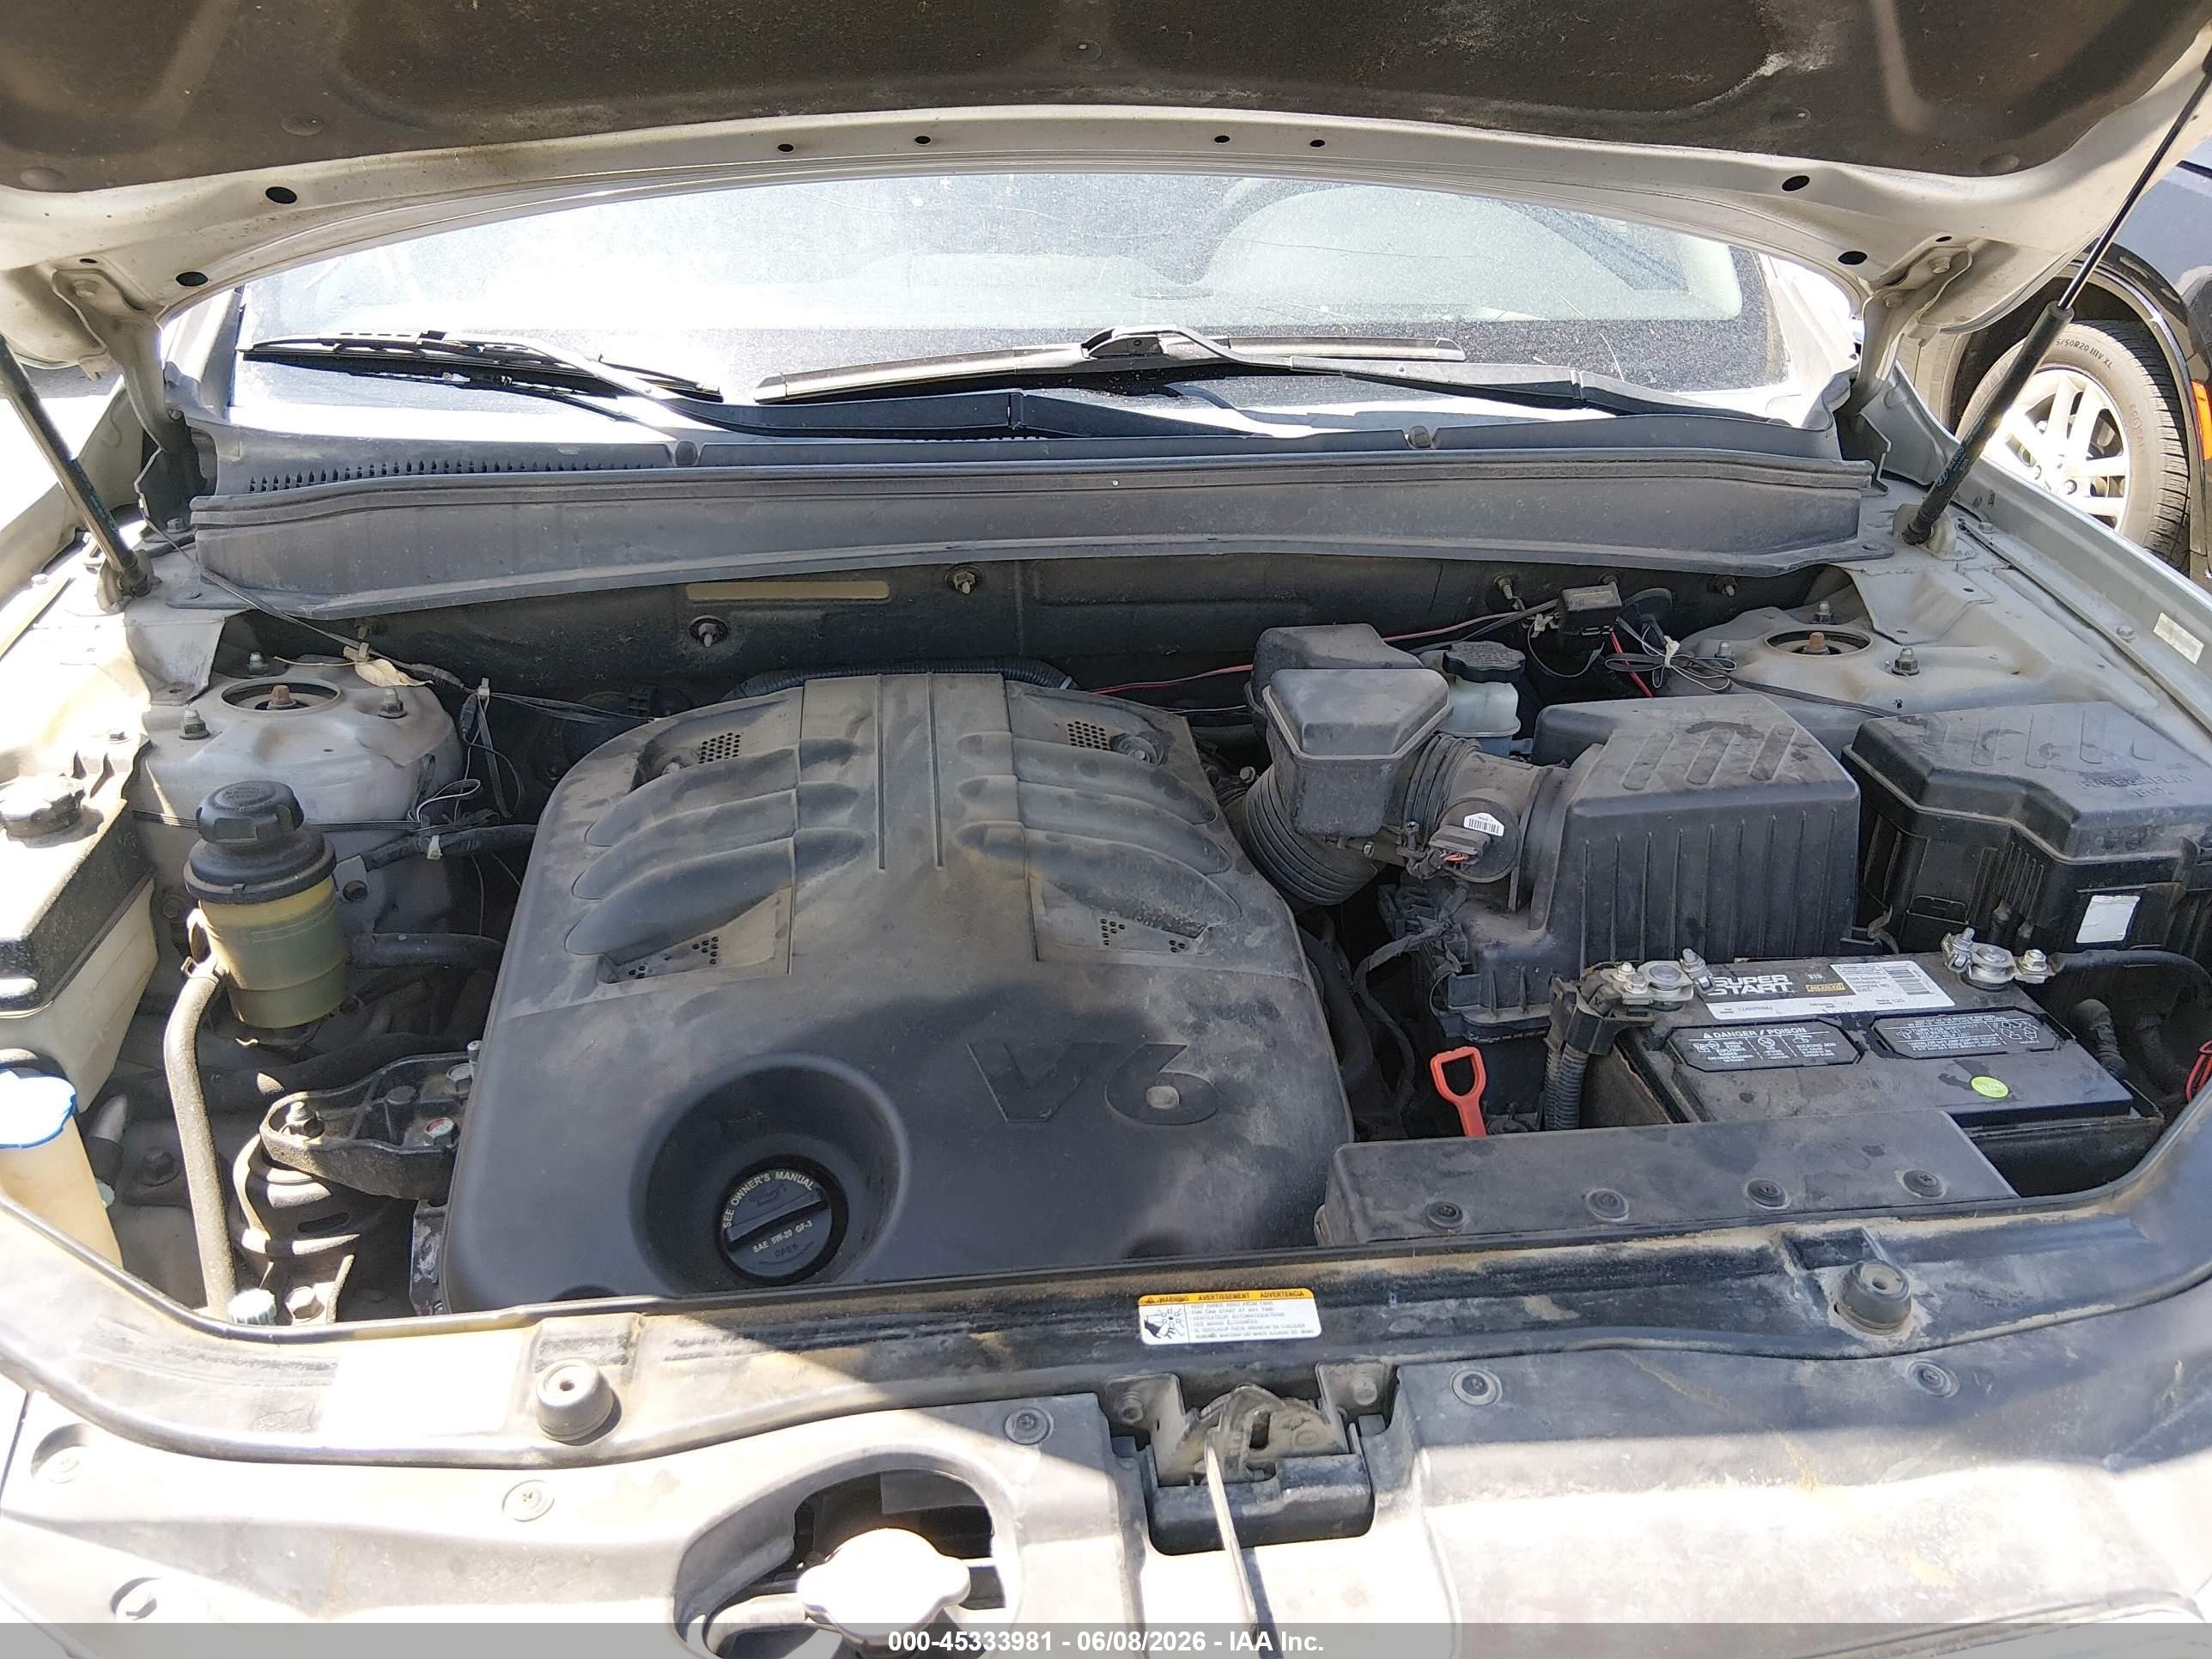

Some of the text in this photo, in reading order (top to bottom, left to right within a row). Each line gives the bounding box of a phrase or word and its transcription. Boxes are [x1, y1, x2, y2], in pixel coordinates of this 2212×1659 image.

[2104, 358, 2113, 370] XL
[1713, 974, 1789, 986] SUPER
[1707, 982, 1793, 995] START
[1713, 1030, 1757, 1038] DANGER
[1766, 1027, 1807, 1036] POISON
[966, 1042, 1220, 1125] V6
[723, 1171, 814, 1229] SEE OWNER'S MANUAL
[752, 1240, 769, 1253] SAE
